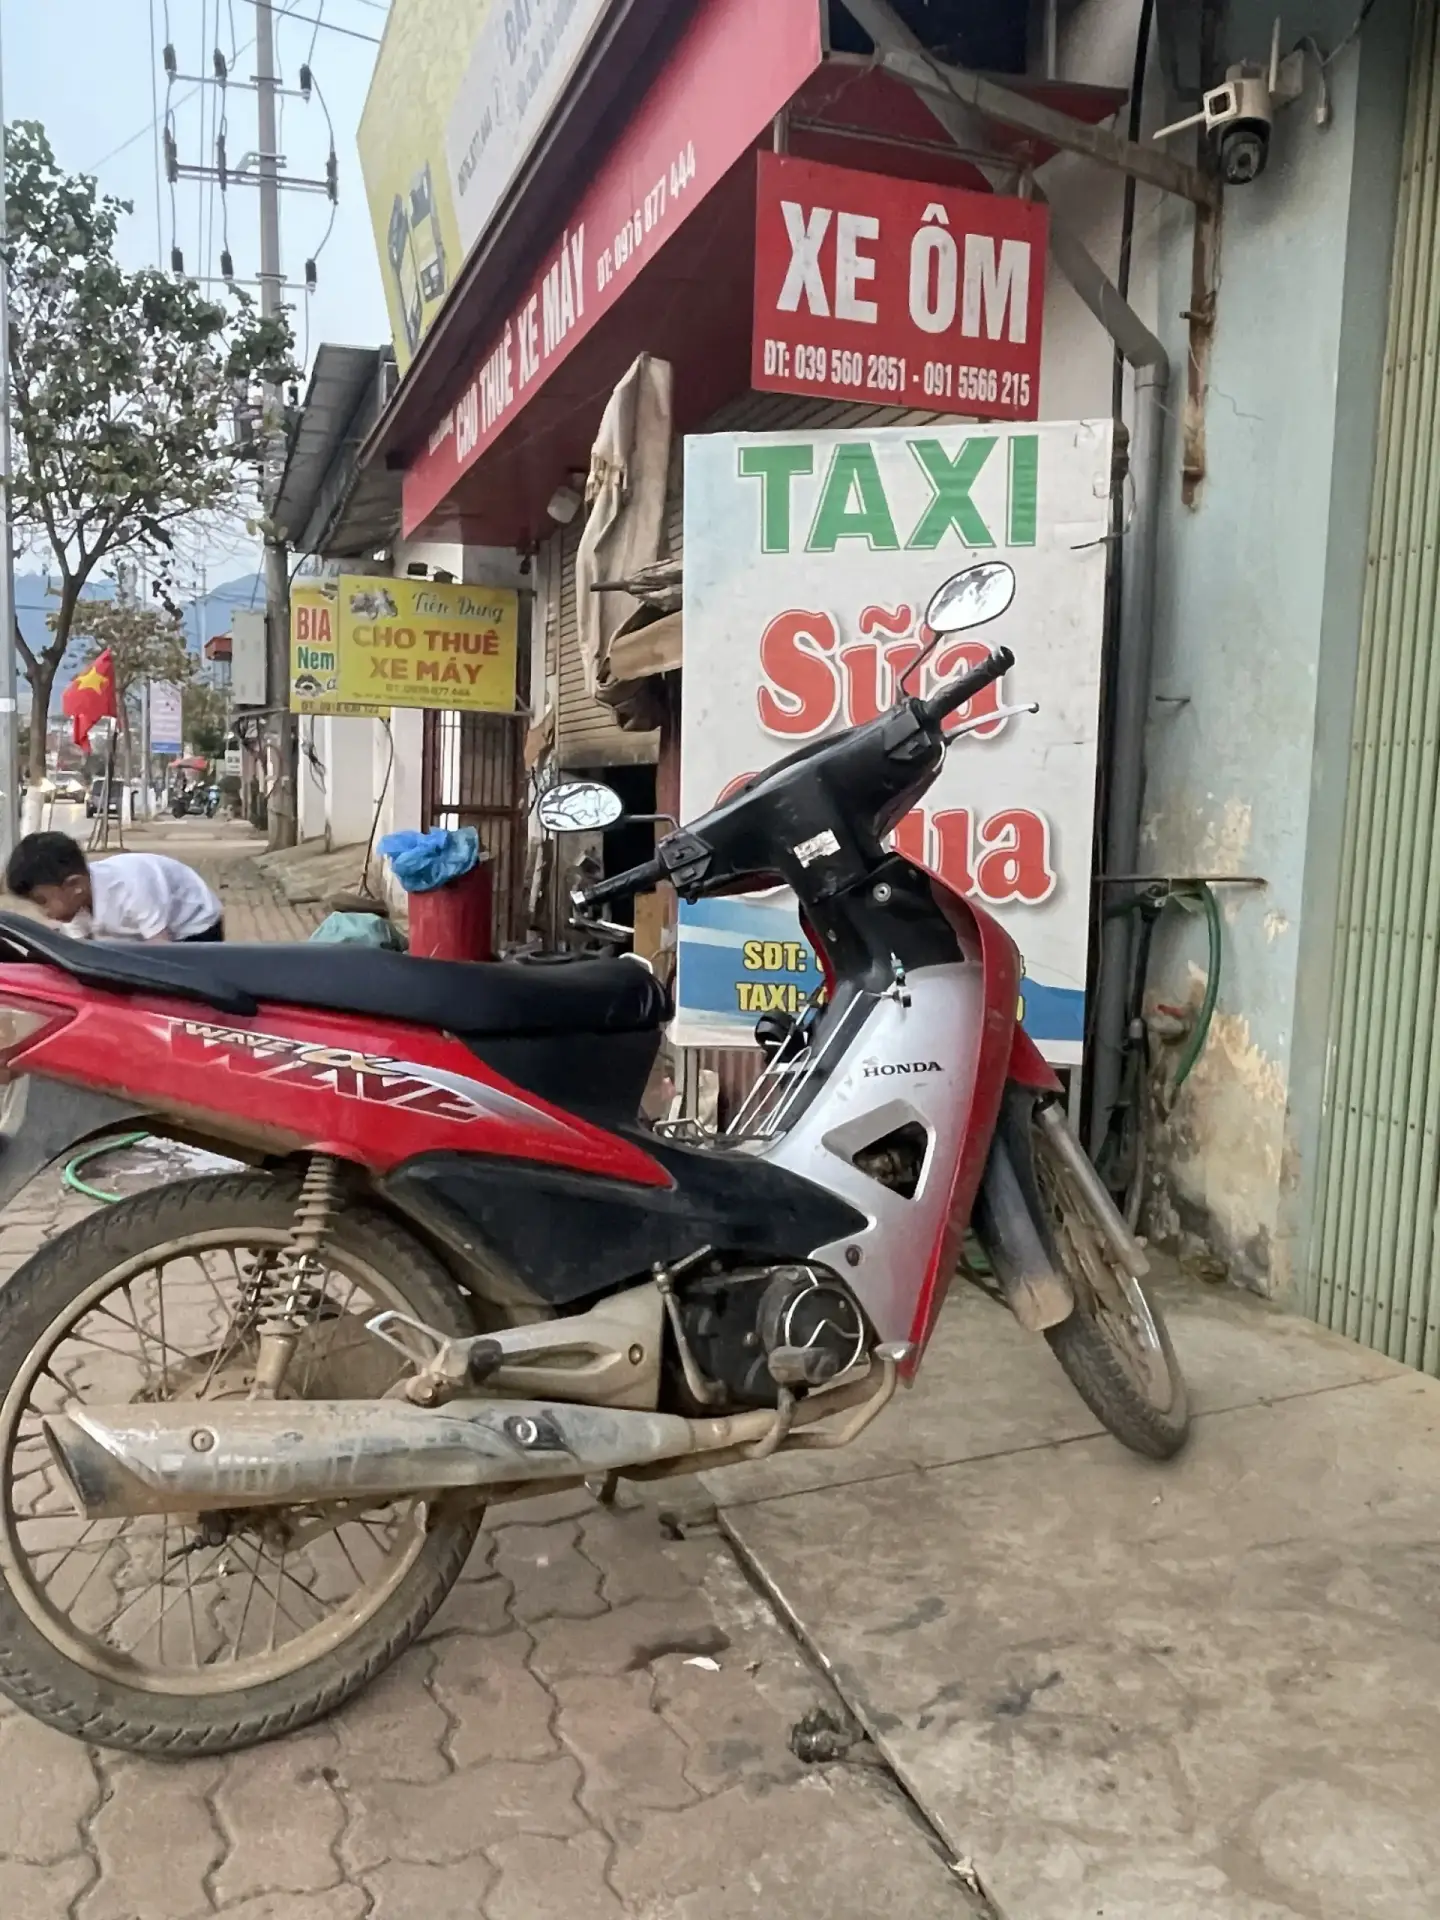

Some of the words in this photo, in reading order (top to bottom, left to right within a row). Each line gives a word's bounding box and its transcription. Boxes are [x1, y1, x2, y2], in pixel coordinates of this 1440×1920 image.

[614, 207, 643, 271] 0976
[644, 174, 667, 233] 877
[670, 140, 696, 199] 444
[775, 200, 880, 324] XE
[908, 202, 1032, 344] ÔM
[480, 319, 514, 433] THUÊ
[517, 293, 540, 390] XE
[542, 222, 586, 358] MÁY
[794, 344, 827, 382] 039
[830, 350, 863, 387] 560
[866, 354, 907, 392] 2851
[923, 361, 953, 397] 091
[957, 365, 998, 402] 5566
[1001, 371, 1030, 406] 215
[737, 434, 1039, 554] TAXI
[296, 606, 332, 642] BIA
[352, 625, 417, 650] CHO
[423, 629, 499, 656] THUÊ
[297, 646, 335, 671] Nem
[369, 656, 409, 682] XE
[416, 656, 483, 686] MÁY
[756, 602, 1008, 740] Sữa
[184, 1020, 296, 1054] WAVE
[863, 1060, 945, 1078] HONDA
